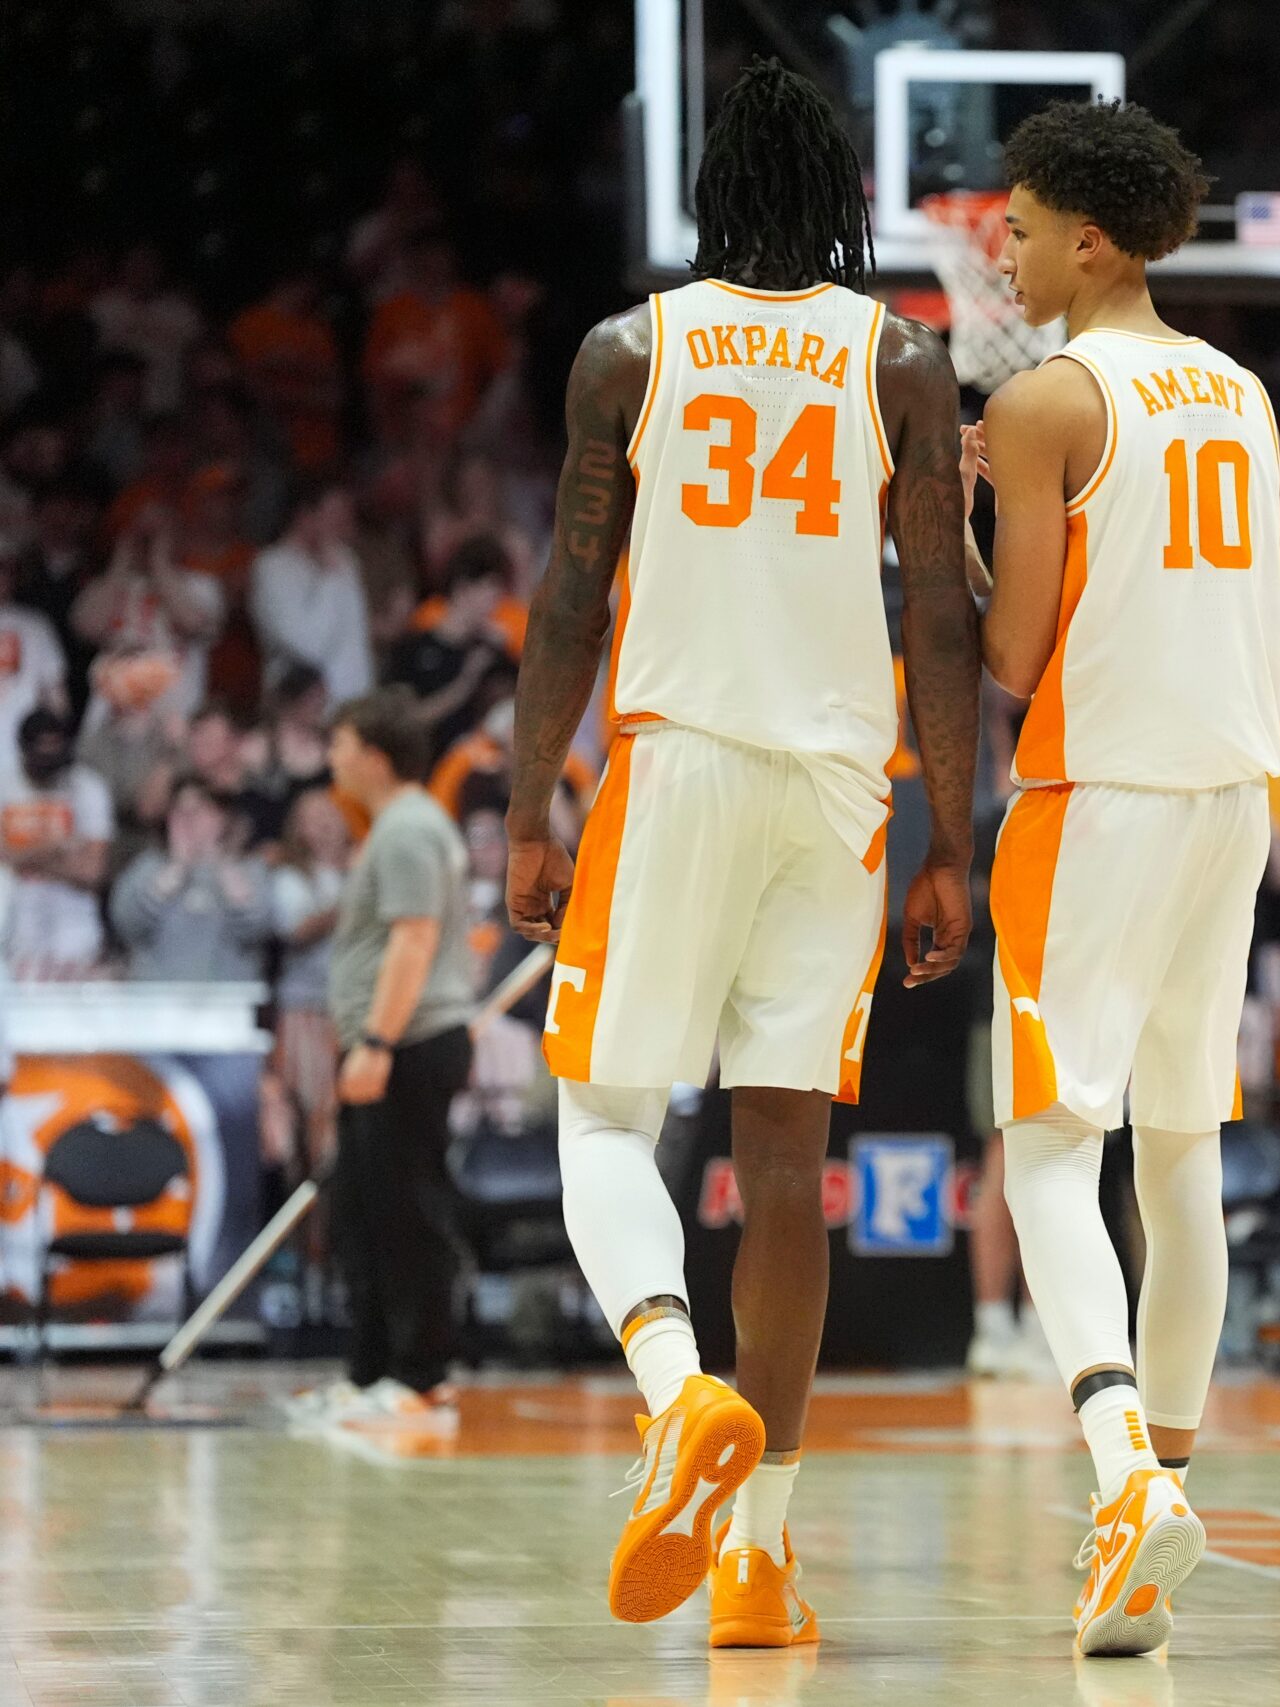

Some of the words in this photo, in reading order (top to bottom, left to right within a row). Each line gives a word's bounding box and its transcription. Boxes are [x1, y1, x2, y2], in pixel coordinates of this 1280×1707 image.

[686, 324, 850, 390] OKPARA
[1131, 366, 1245, 417] AMENT
[681, 393, 842, 538] 34
[1162, 438, 1253, 570] 10
